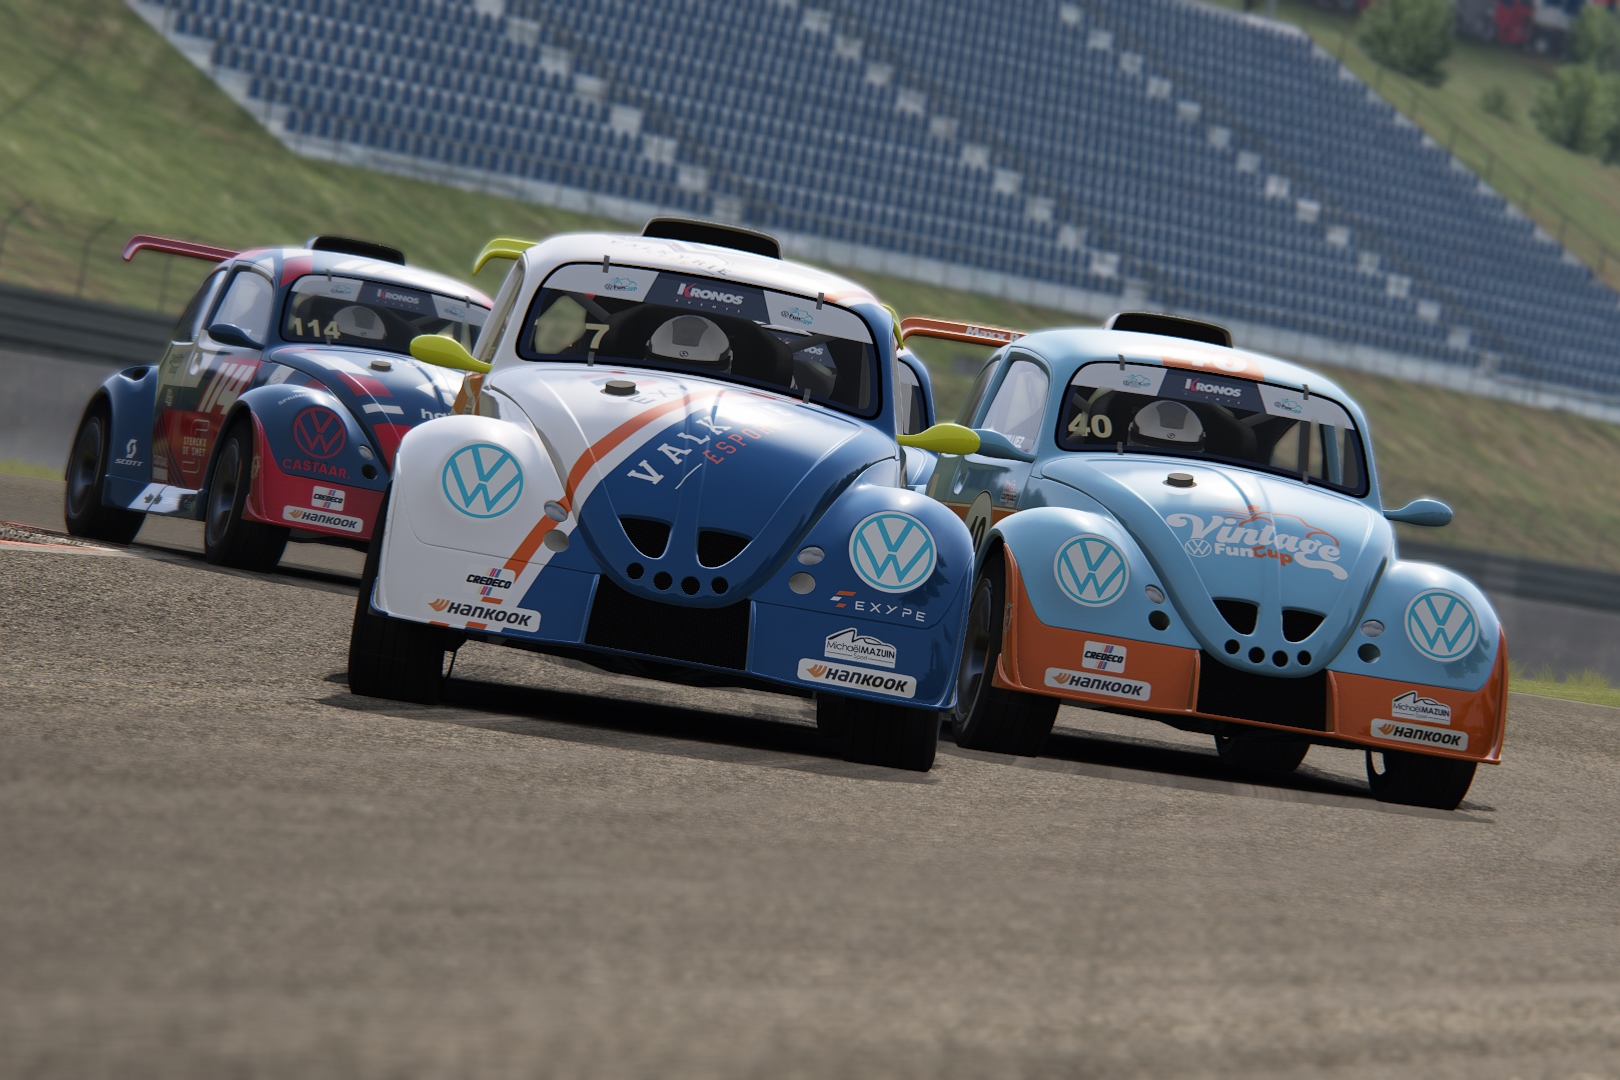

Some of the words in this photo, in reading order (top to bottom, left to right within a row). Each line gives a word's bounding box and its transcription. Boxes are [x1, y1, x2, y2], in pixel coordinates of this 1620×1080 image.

[377, 288, 419, 304] KRONOS
[677, 282, 744, 305] KRONOS
[292, 318, 341, 339] 114
[965, 326, 1006, 340] Maxx
[1184, 378, 1241, 397] KRONOS
[1068, 413, 1112, 438] 40
[114, 458, 144, 466] SCOTT
[313, 492, 344, 504] CREDECO
[1166, 513, 1348, 580] Vintage
[466, 574, 512, 589] CREDECO
[854, 601, 926, 622] EXYPE
[1084, 650, 1124, 663] CREDECO
